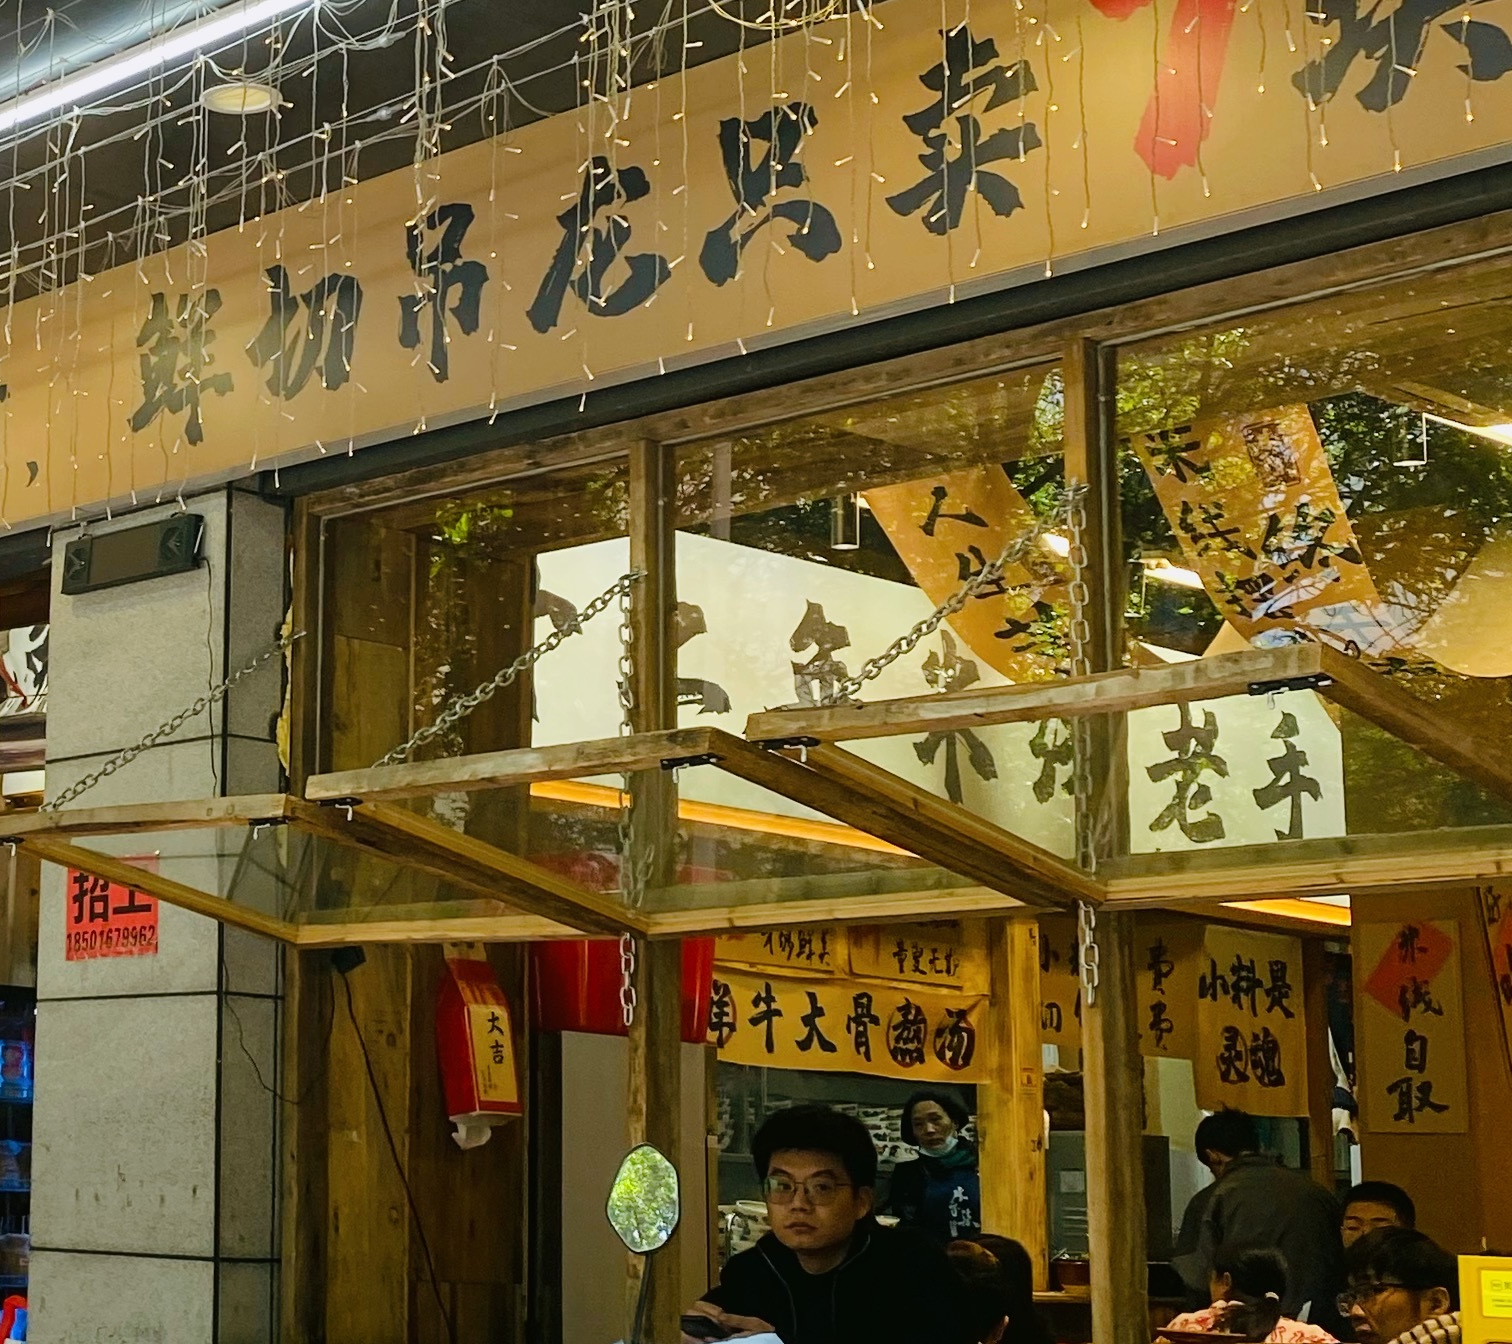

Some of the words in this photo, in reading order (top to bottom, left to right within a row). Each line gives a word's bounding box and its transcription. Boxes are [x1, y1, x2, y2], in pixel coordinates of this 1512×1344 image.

[1198, 954, 1295, 1019] 小料是
[487, 1011, 505, 1065] 大吉
